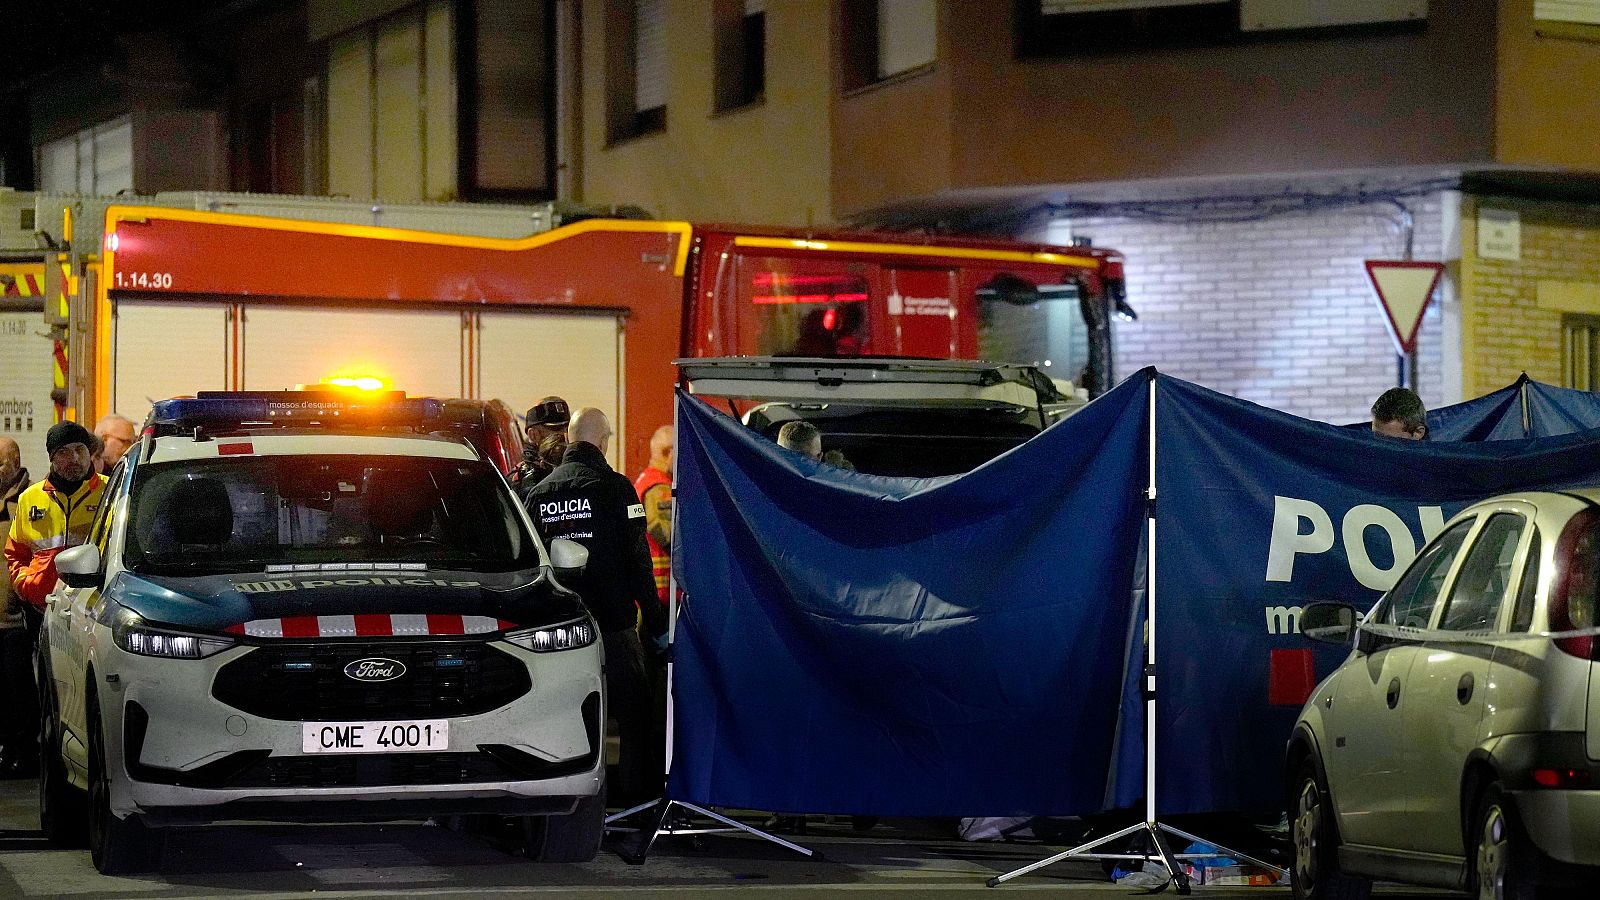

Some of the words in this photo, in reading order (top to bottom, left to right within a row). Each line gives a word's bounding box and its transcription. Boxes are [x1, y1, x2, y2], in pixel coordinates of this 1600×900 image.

[115, 271, 173, 289] 1.14.30
[269, 401, 300, 409] mossos
[301, 401, 344, 410] d'esquadra
[540, 499, 592, 517] POLICIA
[561, 511, 592, 521] d'esquadra
[301, 577, 481, 589] policia
[355, 661, 394, 678] Ford
[320, 726, 365, 748] CME
[376, 724, 433, 748] 4001
